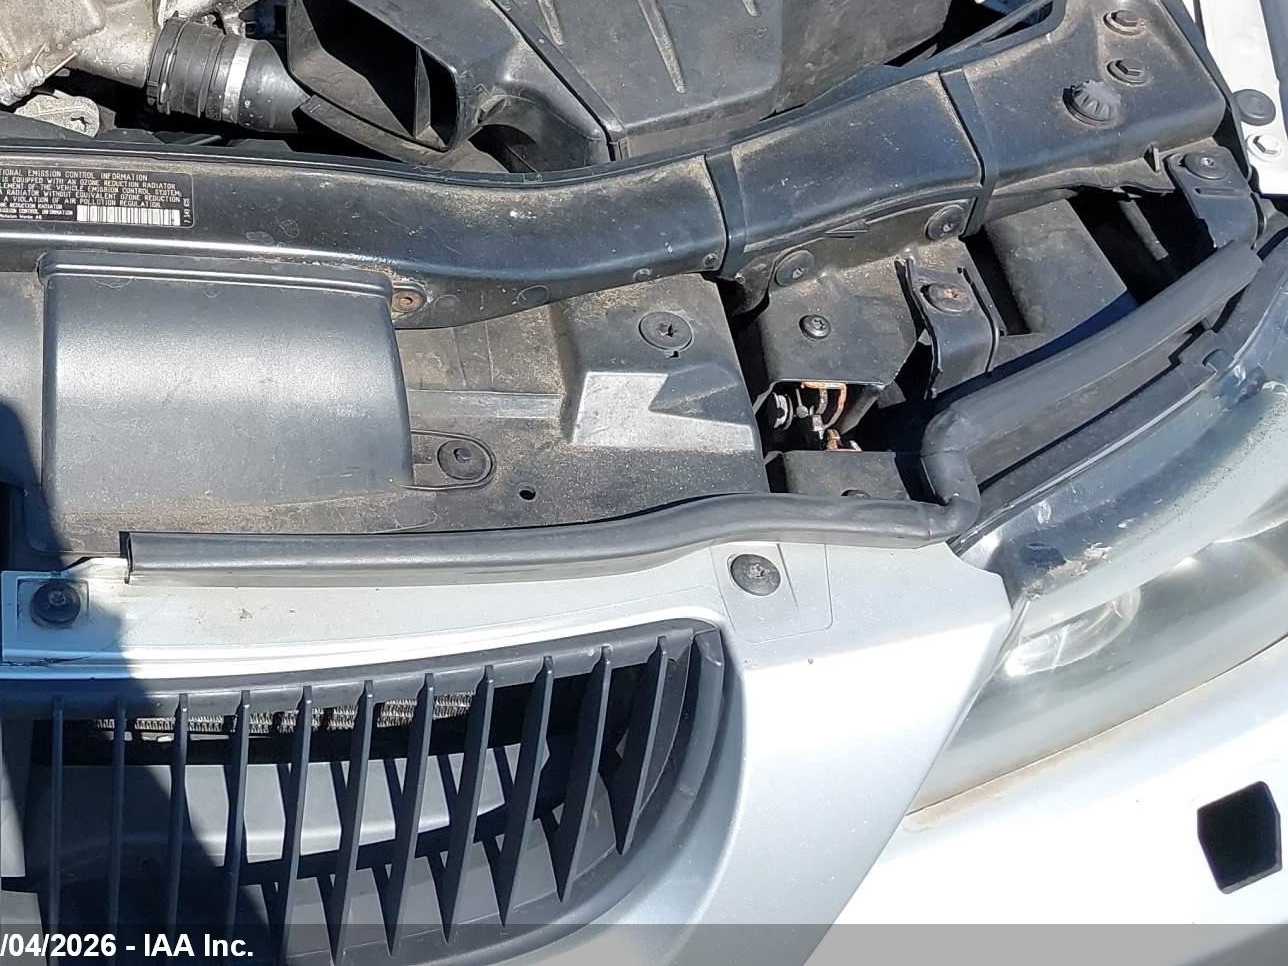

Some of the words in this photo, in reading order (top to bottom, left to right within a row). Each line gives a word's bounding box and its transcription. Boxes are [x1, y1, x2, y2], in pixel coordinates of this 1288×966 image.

[27, 169, 62, 177] EMISSION
[64, 170, 97, 179] CONTROL
[100, 172, 148, 181] INFORMATION
[12, 176, 43, 184] EQUIPPED
[46, 177, 65, 185] WITH
[103, 180, 139, 188] REDUCTION
[142, 182, 176, 190] RADIATOR
[122, 187, 151, 195] CONTROL
[79, 198, 116, 206] POLLUTION
[144, 195, 181, 203] REDUCTION
